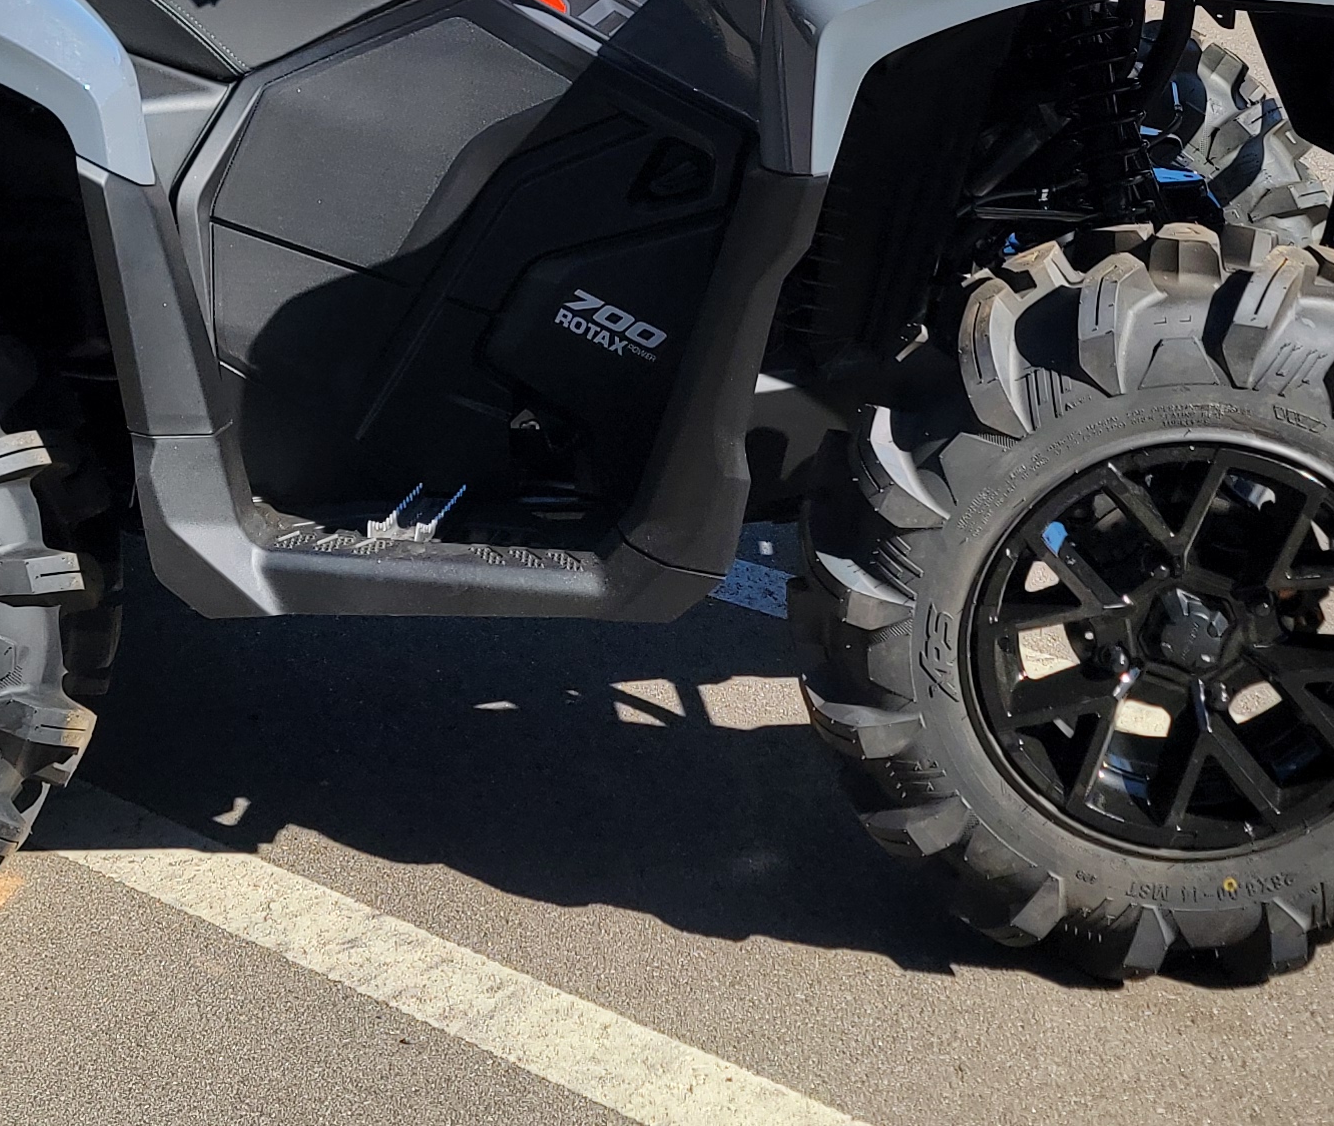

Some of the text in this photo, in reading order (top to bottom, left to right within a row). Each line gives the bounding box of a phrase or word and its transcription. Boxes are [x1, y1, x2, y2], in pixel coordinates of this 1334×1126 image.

[554, 308, 657, 362] ROTAX POWER
[563, 288, 668, 350] 700
